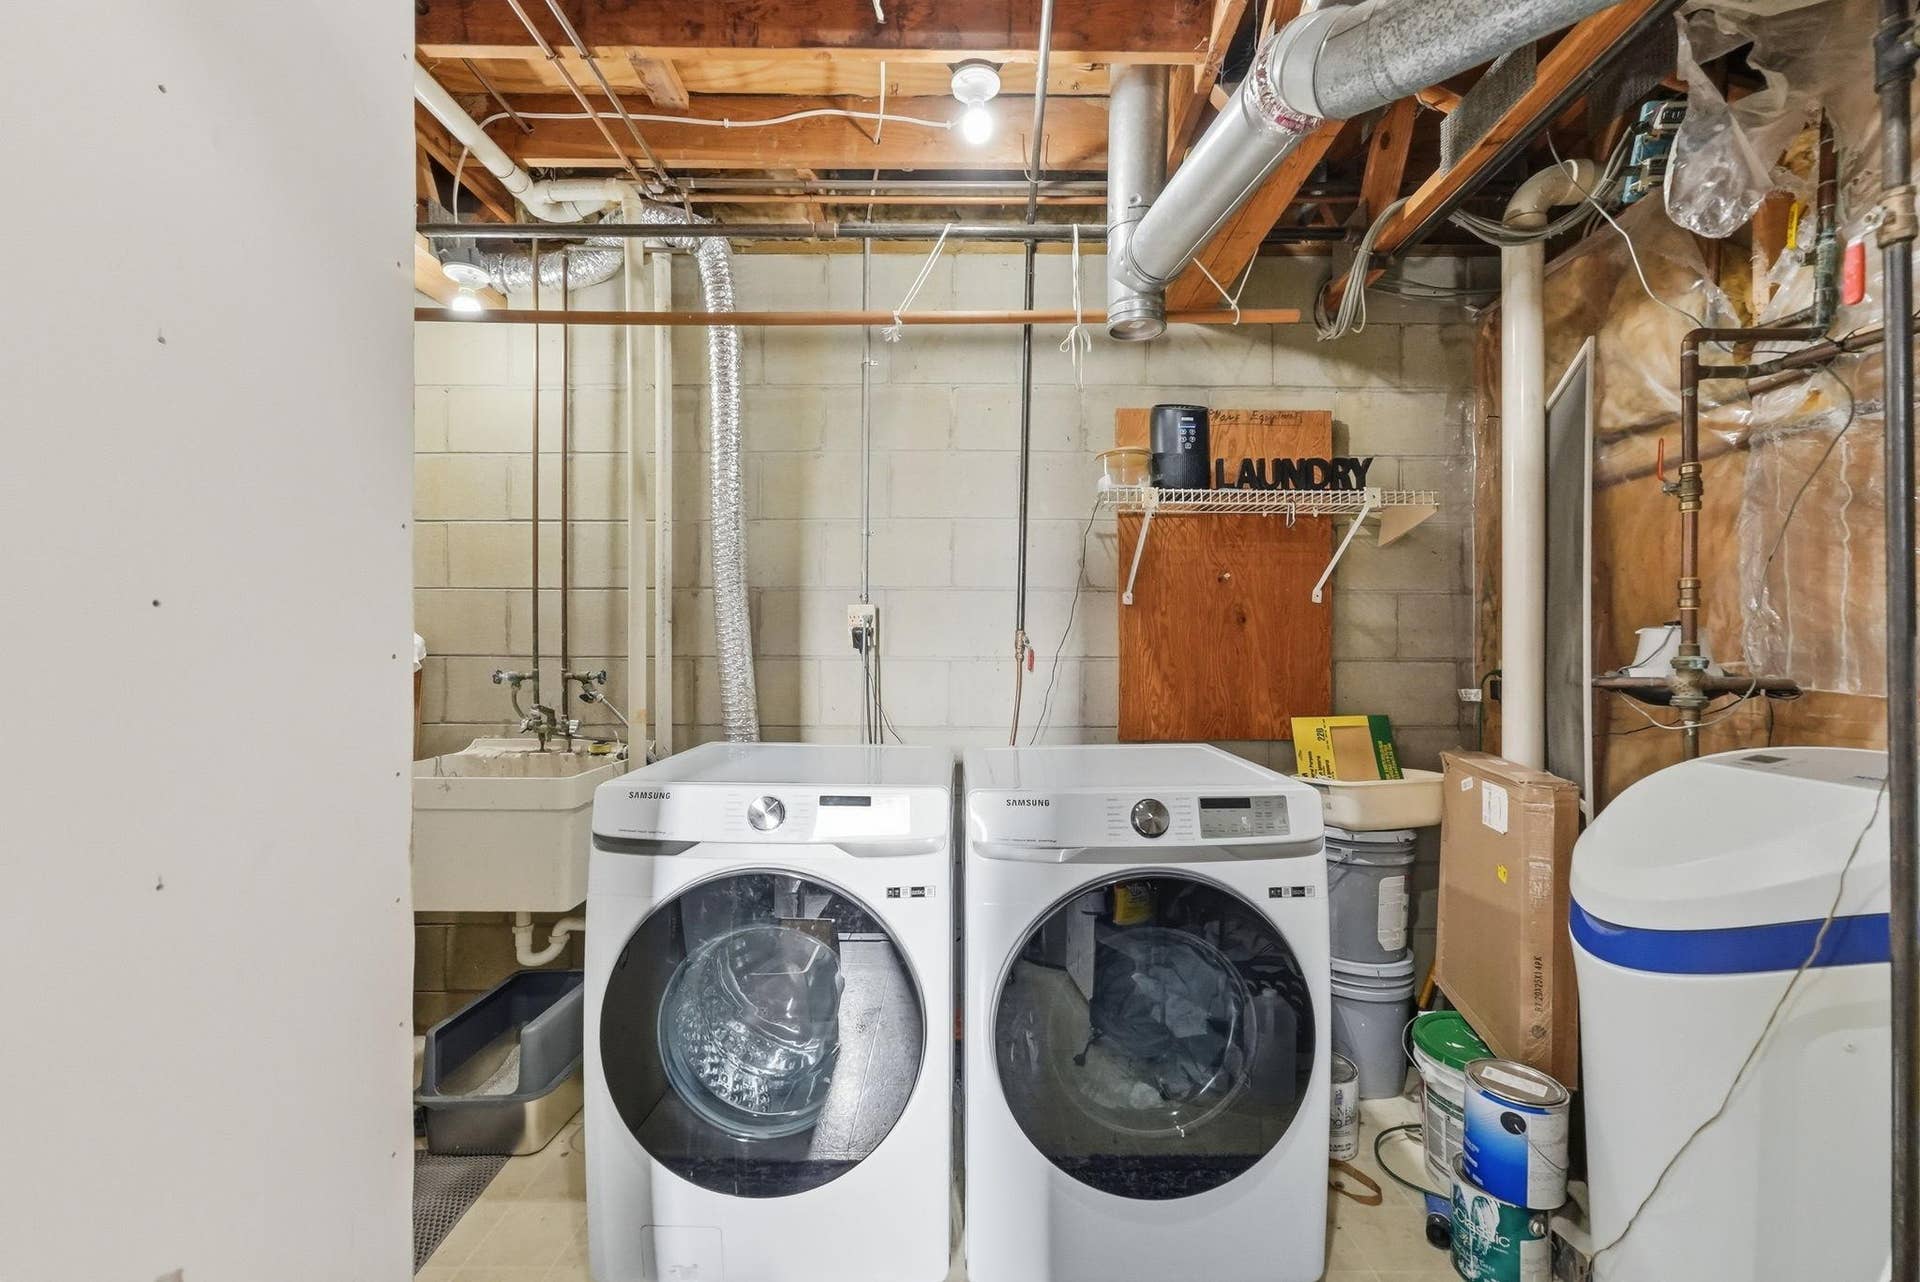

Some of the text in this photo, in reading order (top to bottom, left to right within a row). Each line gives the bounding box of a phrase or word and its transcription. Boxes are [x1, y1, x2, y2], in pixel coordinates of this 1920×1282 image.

[1215, 457, 1374, 490] LAUNDRY
[1316, 728, 1325, 741] 220
[628, 791, 671, 800] SAMSUNG
[1006, 799, 1050, 807] SAMSUNG
